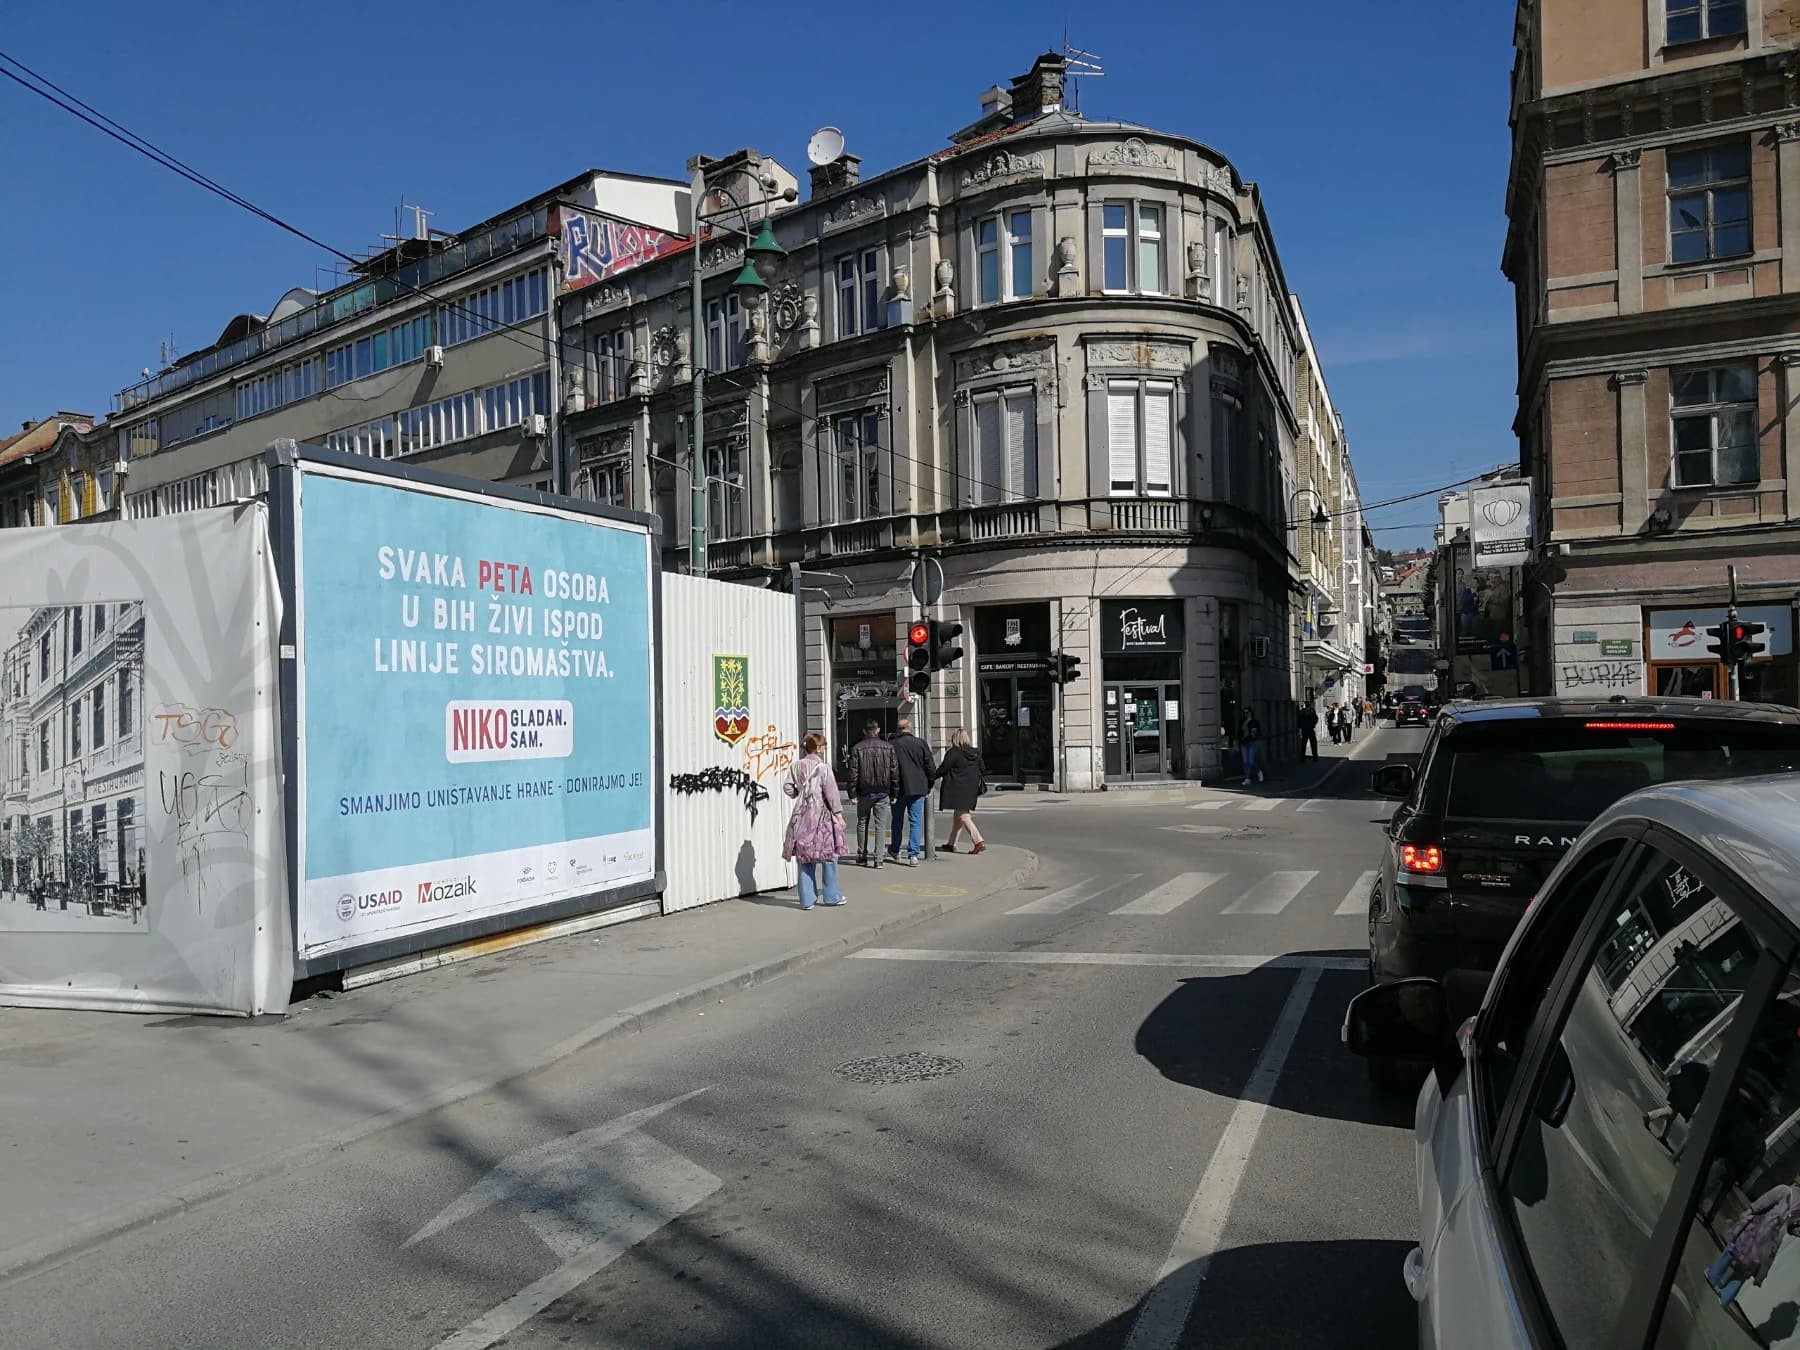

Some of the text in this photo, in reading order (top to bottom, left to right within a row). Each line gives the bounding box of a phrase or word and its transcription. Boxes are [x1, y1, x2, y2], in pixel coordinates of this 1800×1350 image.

[1346, 503, 1355, 556] HOTEL
[378, 546, 610, 604] SVAKA PETA OSOBA
[402, 594, 603, 640] U BIH ŽIVI ISPOD
[1120, 607, 1166, 650] Festival
[375, 638, 615, 678] LINIJE SIROMAŠTVA.
[453, 708, 567, 751] NIKO GLADAN.
[510, 730, 543, 748] SAM.
[340, 791, 421, 816] SMANJIMO
[427, 783, 512, 808] UNIŠTAVANJE
[517, 780, 553, 799] HRANE
[566, 774, 625, 794] DONIRAJMO
[629, 772, 643, 787] JE!
[358, 890, 403, 910] USAID
[418, 875, 477, 904] Mozaik
